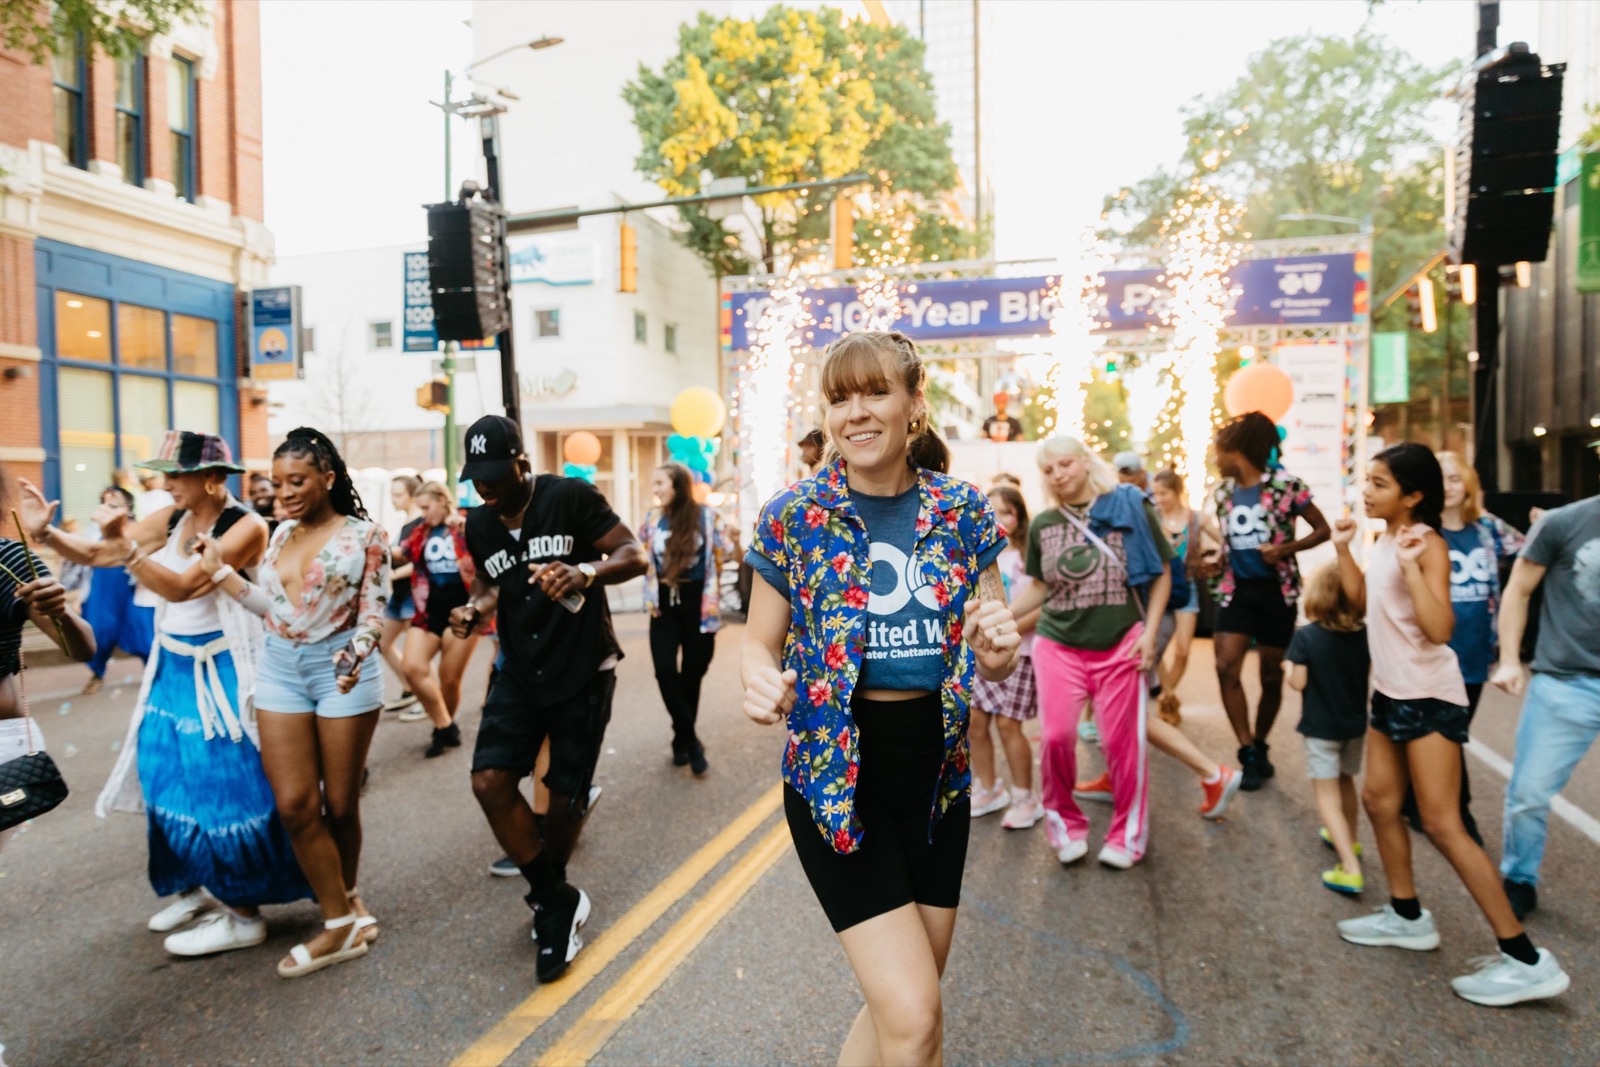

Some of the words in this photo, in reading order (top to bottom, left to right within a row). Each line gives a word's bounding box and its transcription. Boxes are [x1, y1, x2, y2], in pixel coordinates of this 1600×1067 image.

[405, 306, 435, 323] 100
[902, 296, 988, 328] Year
[527, 534, 574, 560] HOOD
[865, 620, 919, 647] ited
[864, 650, 888, 660] ater
[890, 647, 943, 659] Chattanoo
